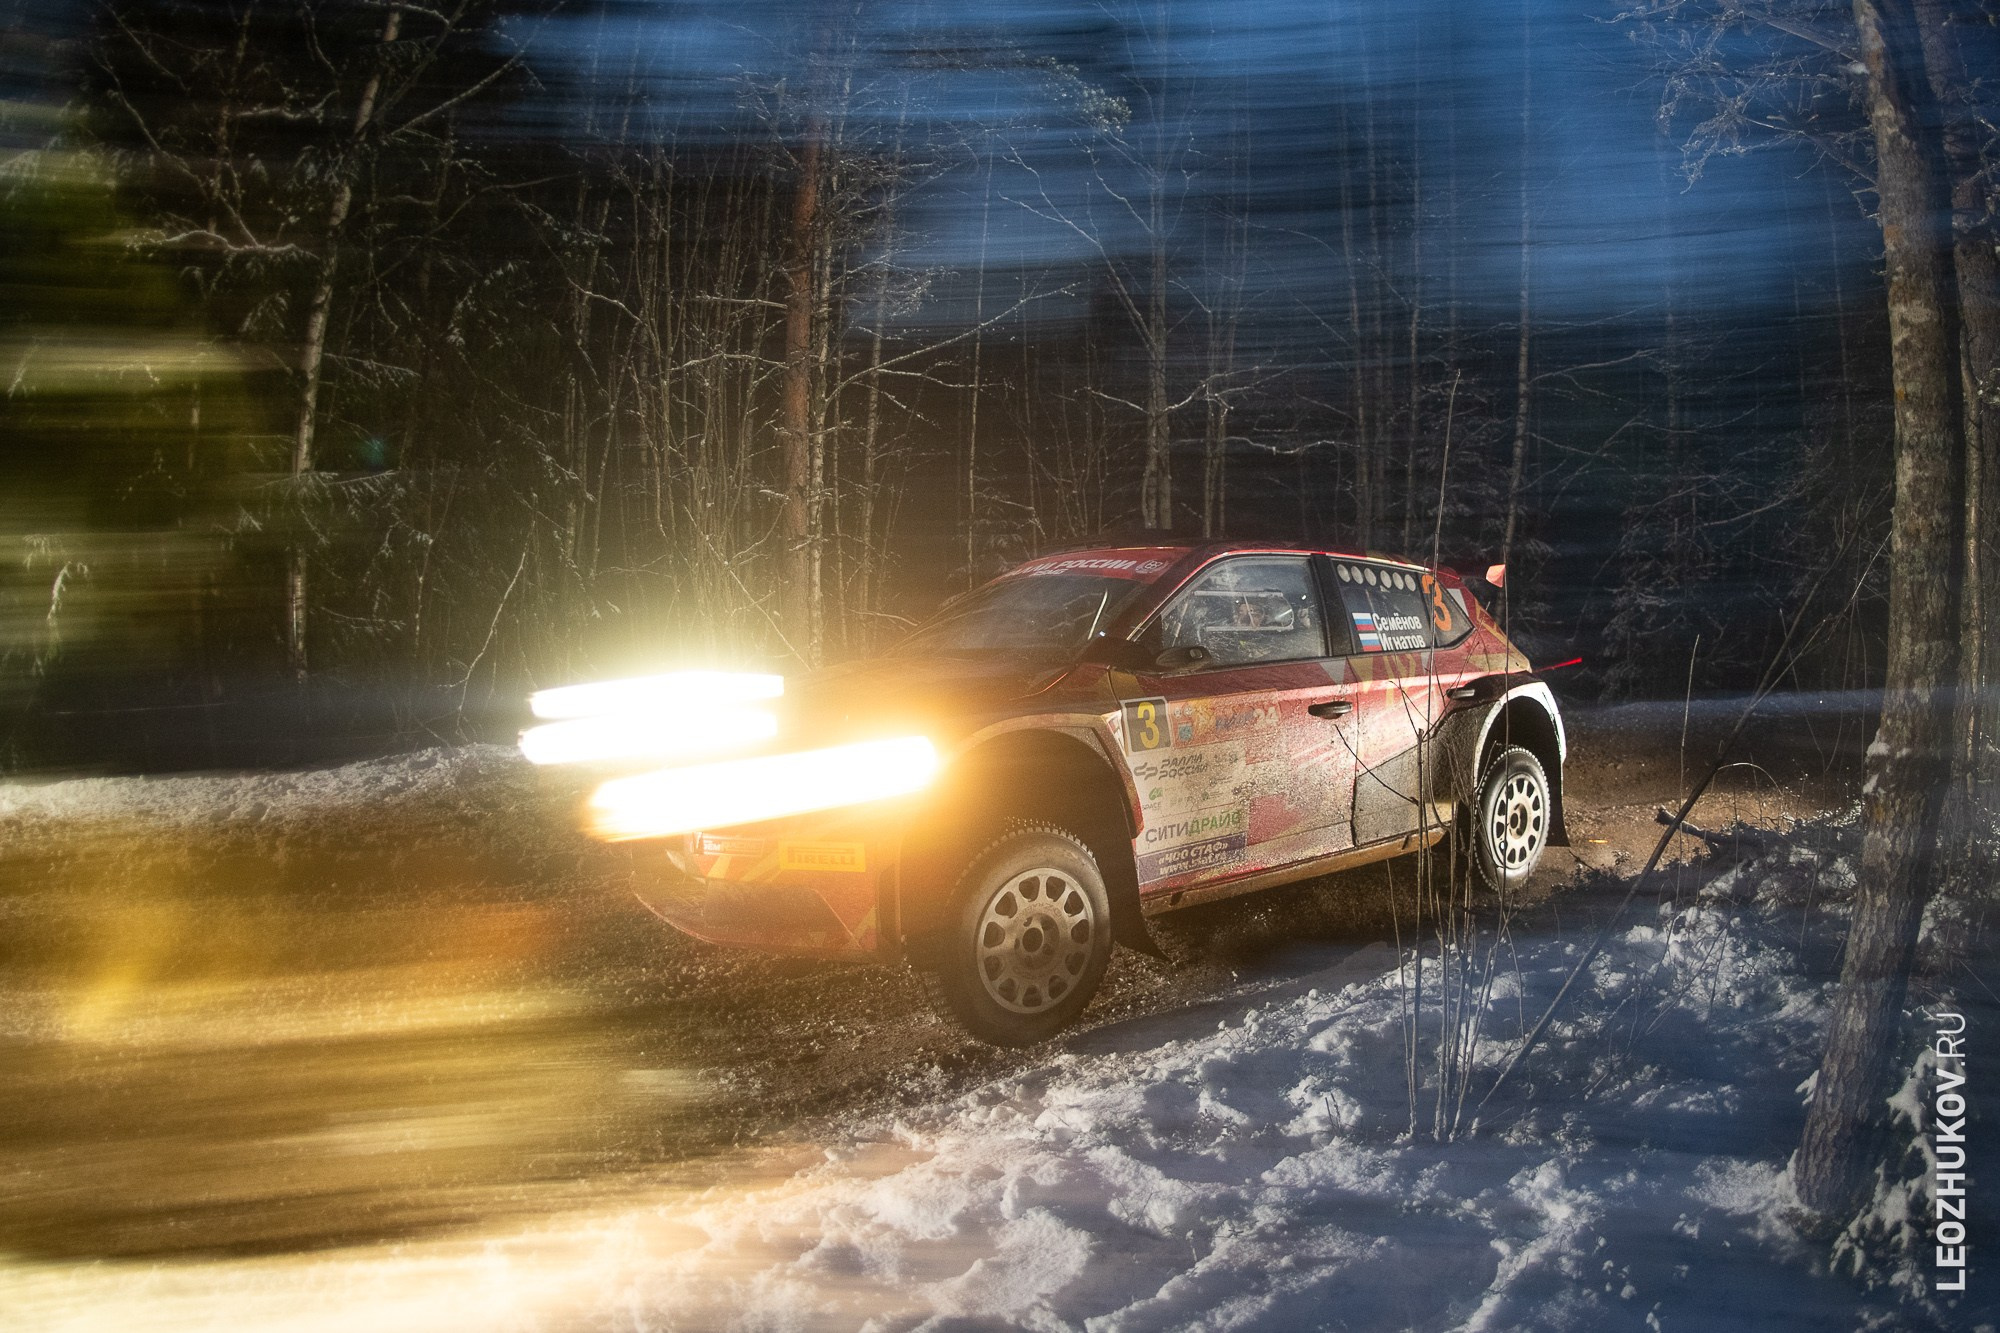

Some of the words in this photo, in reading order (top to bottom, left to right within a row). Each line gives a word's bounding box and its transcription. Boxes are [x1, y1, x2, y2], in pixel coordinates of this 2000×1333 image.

[1054, 559, 1138, 570] РОССИИ
[1421, 573, 1452, 632] 3
[1371, 612, 1423, 632] Семёнов
[1378, 633, 1426, 651] Игнатов
[1137, 701, 1160, 749] 3
[787, 846, 856, 866] PIRELLI
